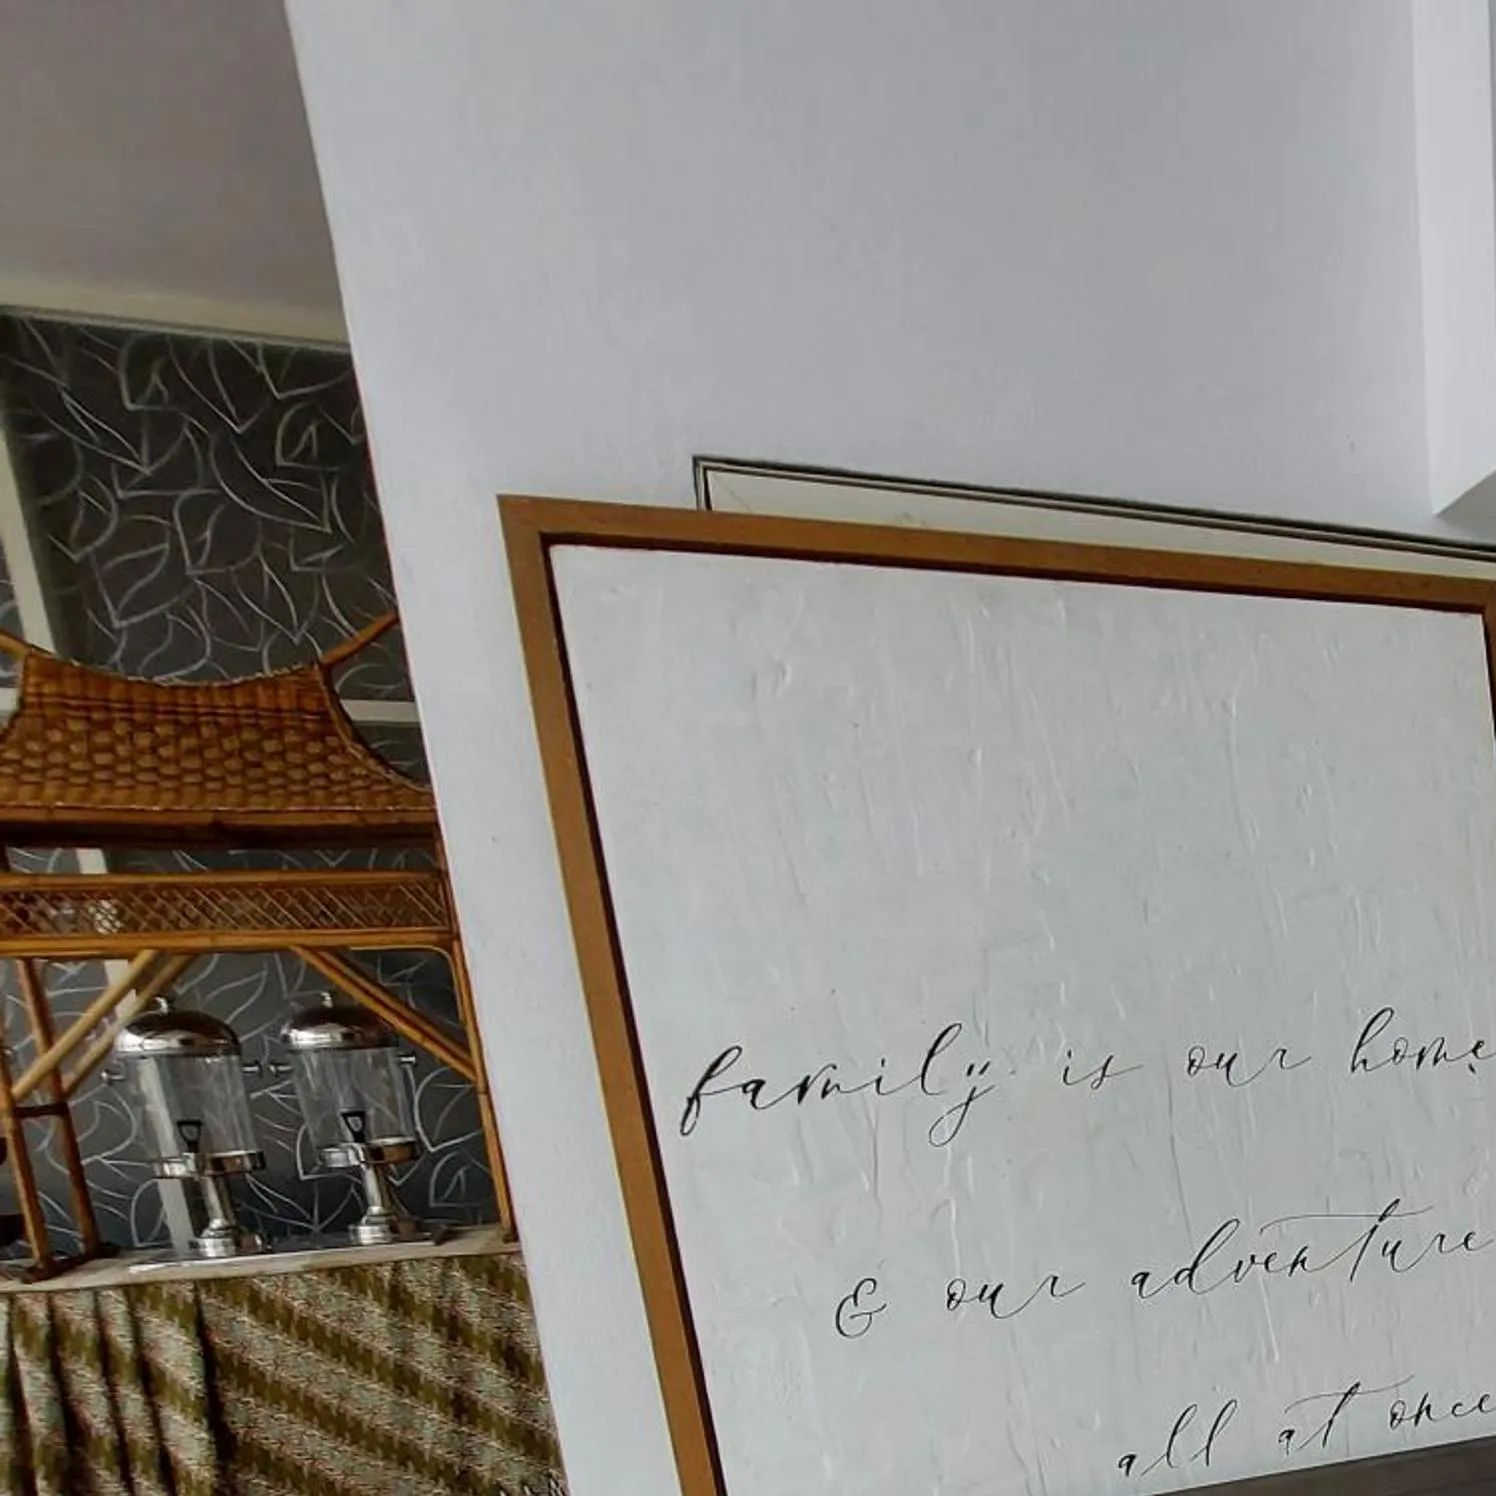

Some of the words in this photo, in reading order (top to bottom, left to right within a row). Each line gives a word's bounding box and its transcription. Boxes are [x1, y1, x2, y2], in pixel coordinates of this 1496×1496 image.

[680, 1022, 996, 1148] family
[1060, 1048, 1143, 1089] is
[1183, 1042, 1314, 1089] our
[945, 1274, 1087, 1320] our
[1118, 1399, 1239, 1477] all
[1278, 1374, 1416, 1454] at
